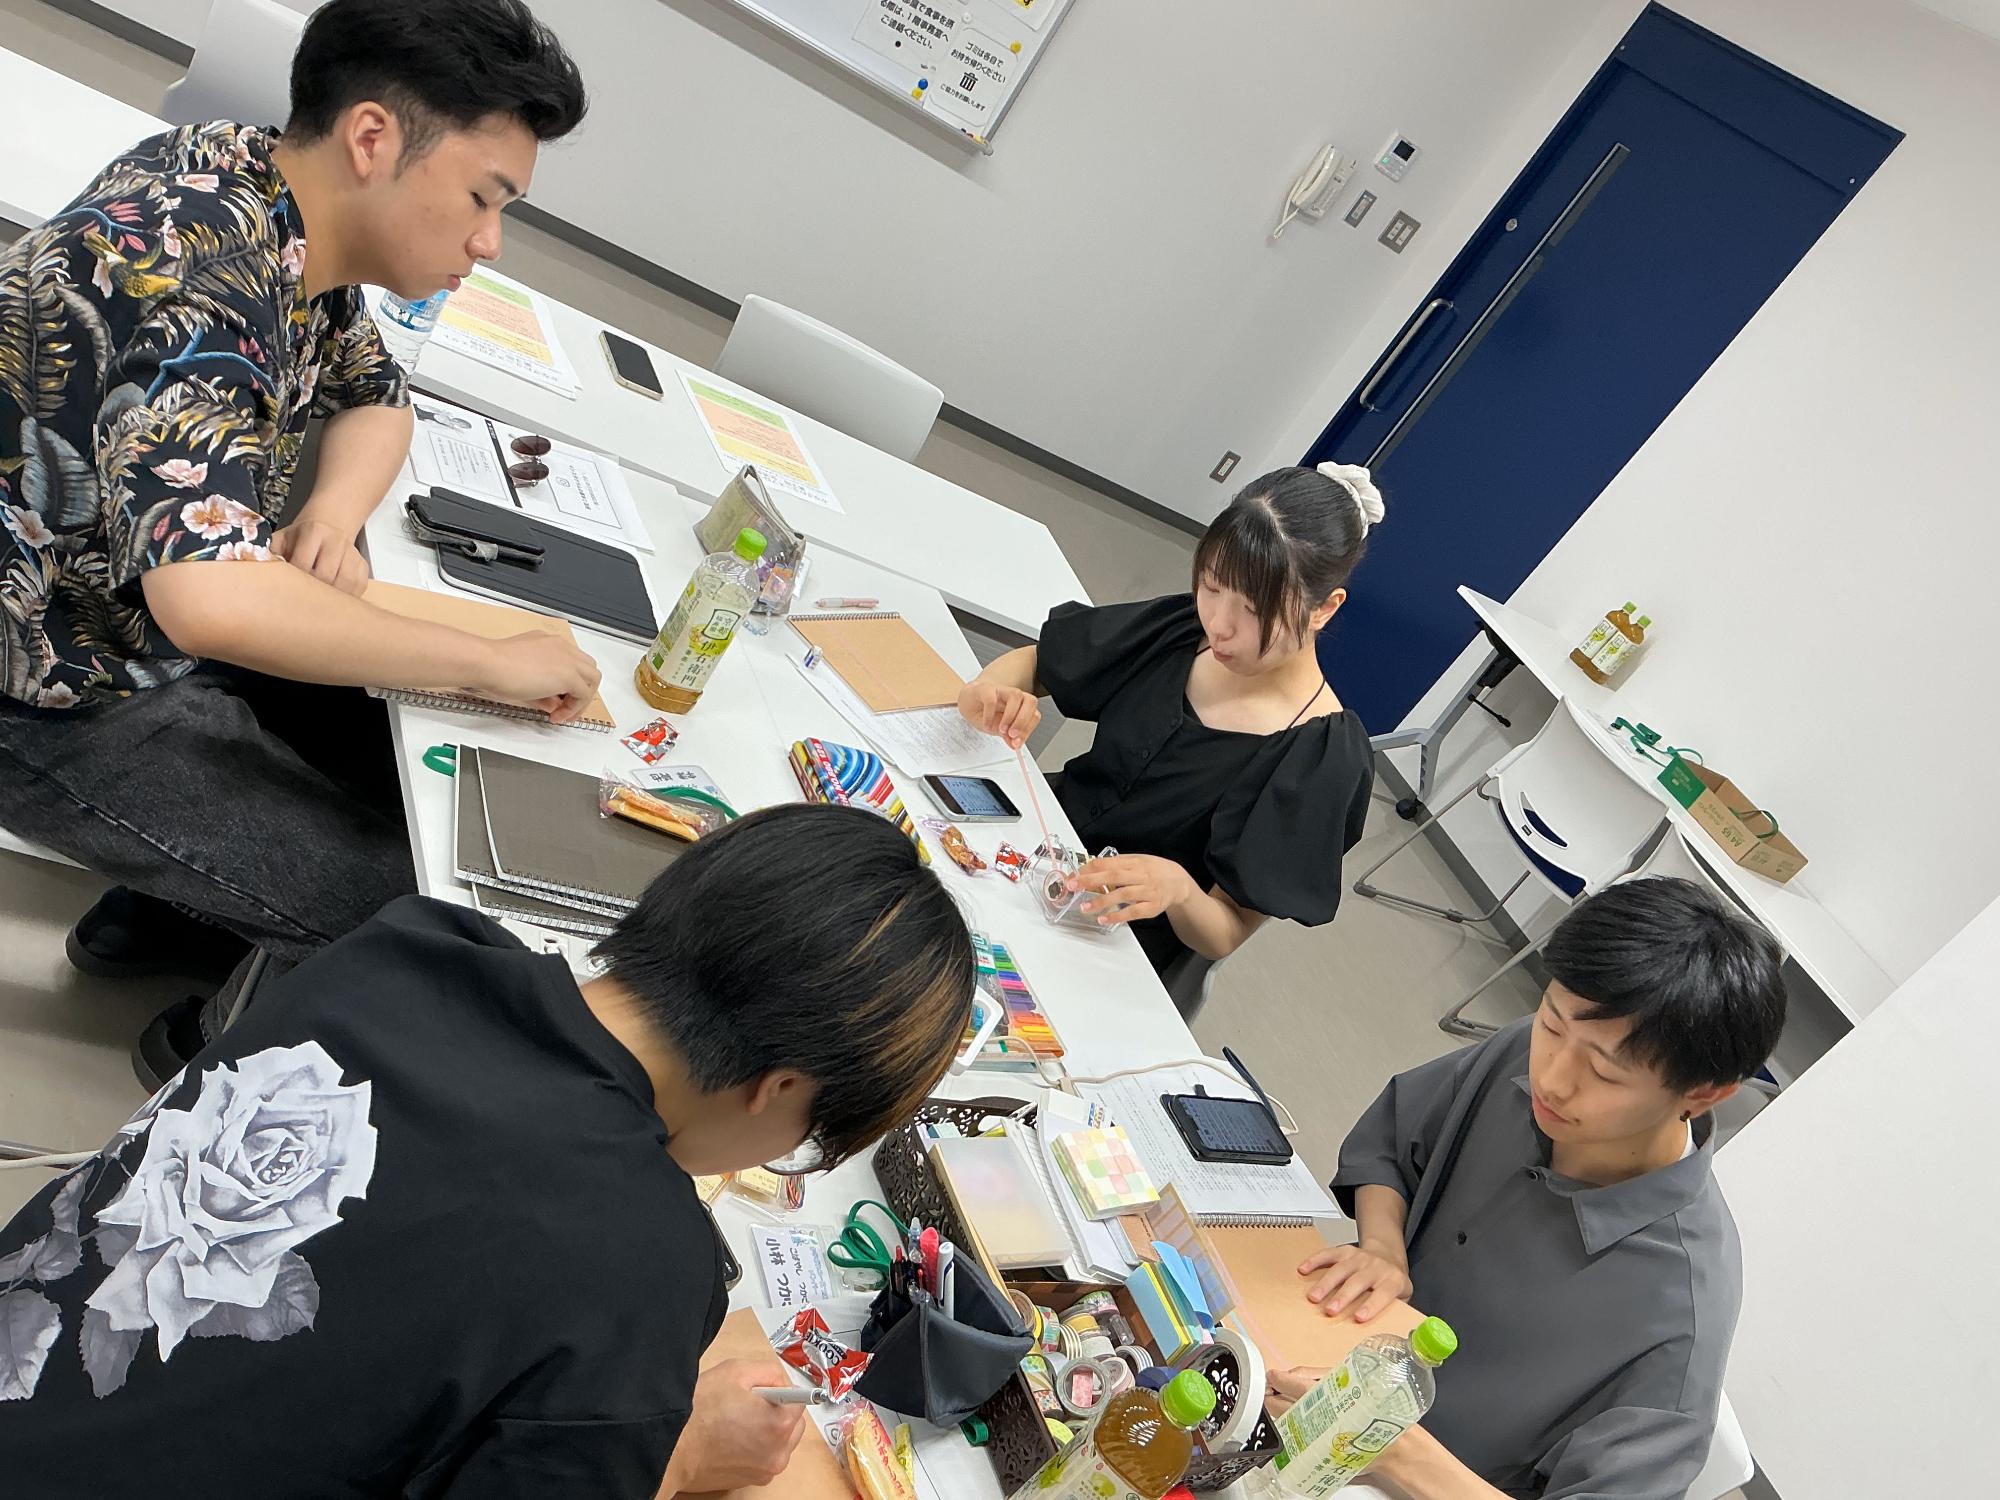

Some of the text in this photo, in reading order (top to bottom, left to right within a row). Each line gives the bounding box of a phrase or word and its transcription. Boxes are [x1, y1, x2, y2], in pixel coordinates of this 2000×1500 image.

[950, 49, 1006, 84] お持ち帰りください
[965, 42, 1004, 68] ゴミは各自で
